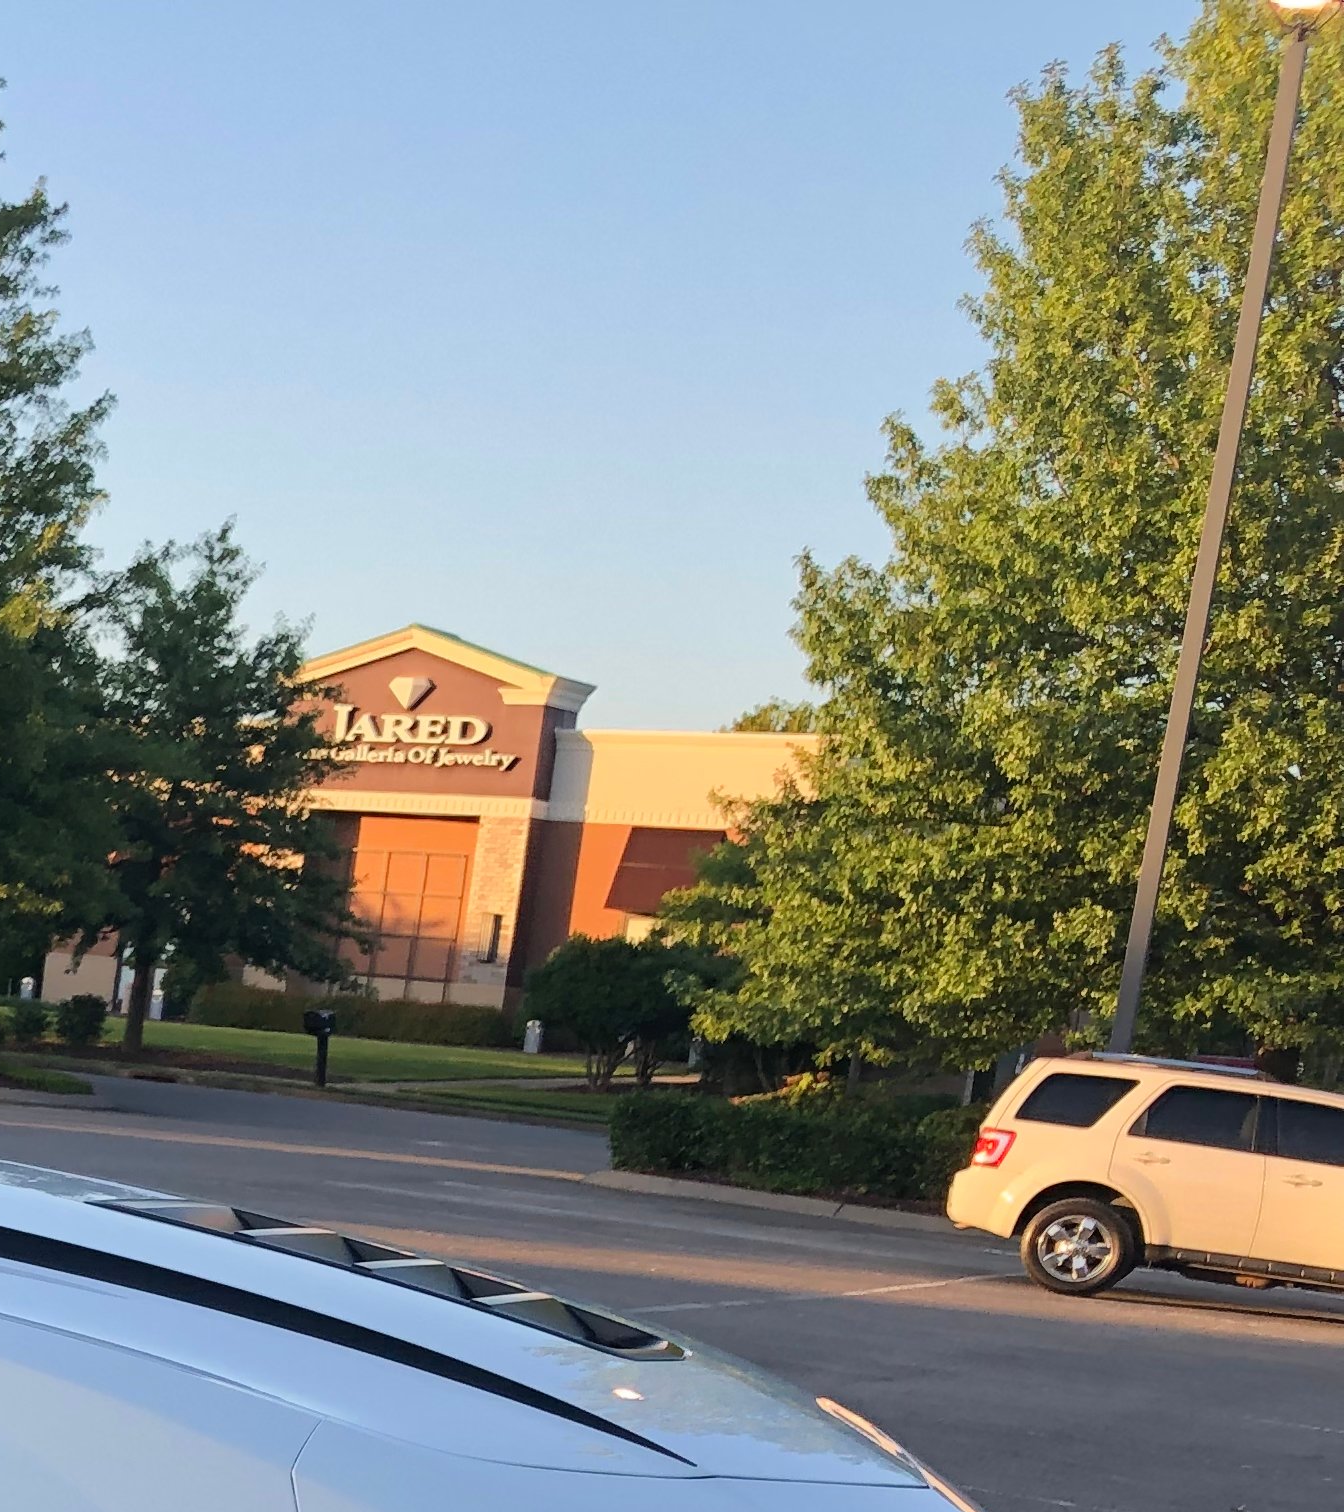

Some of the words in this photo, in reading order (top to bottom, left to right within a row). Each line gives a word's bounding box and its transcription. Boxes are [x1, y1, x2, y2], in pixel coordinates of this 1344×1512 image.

[334, 703, 490, 745] JARED
[408, 746, 433, 764] Of
[432, 747, 518, 772] Jewelry
